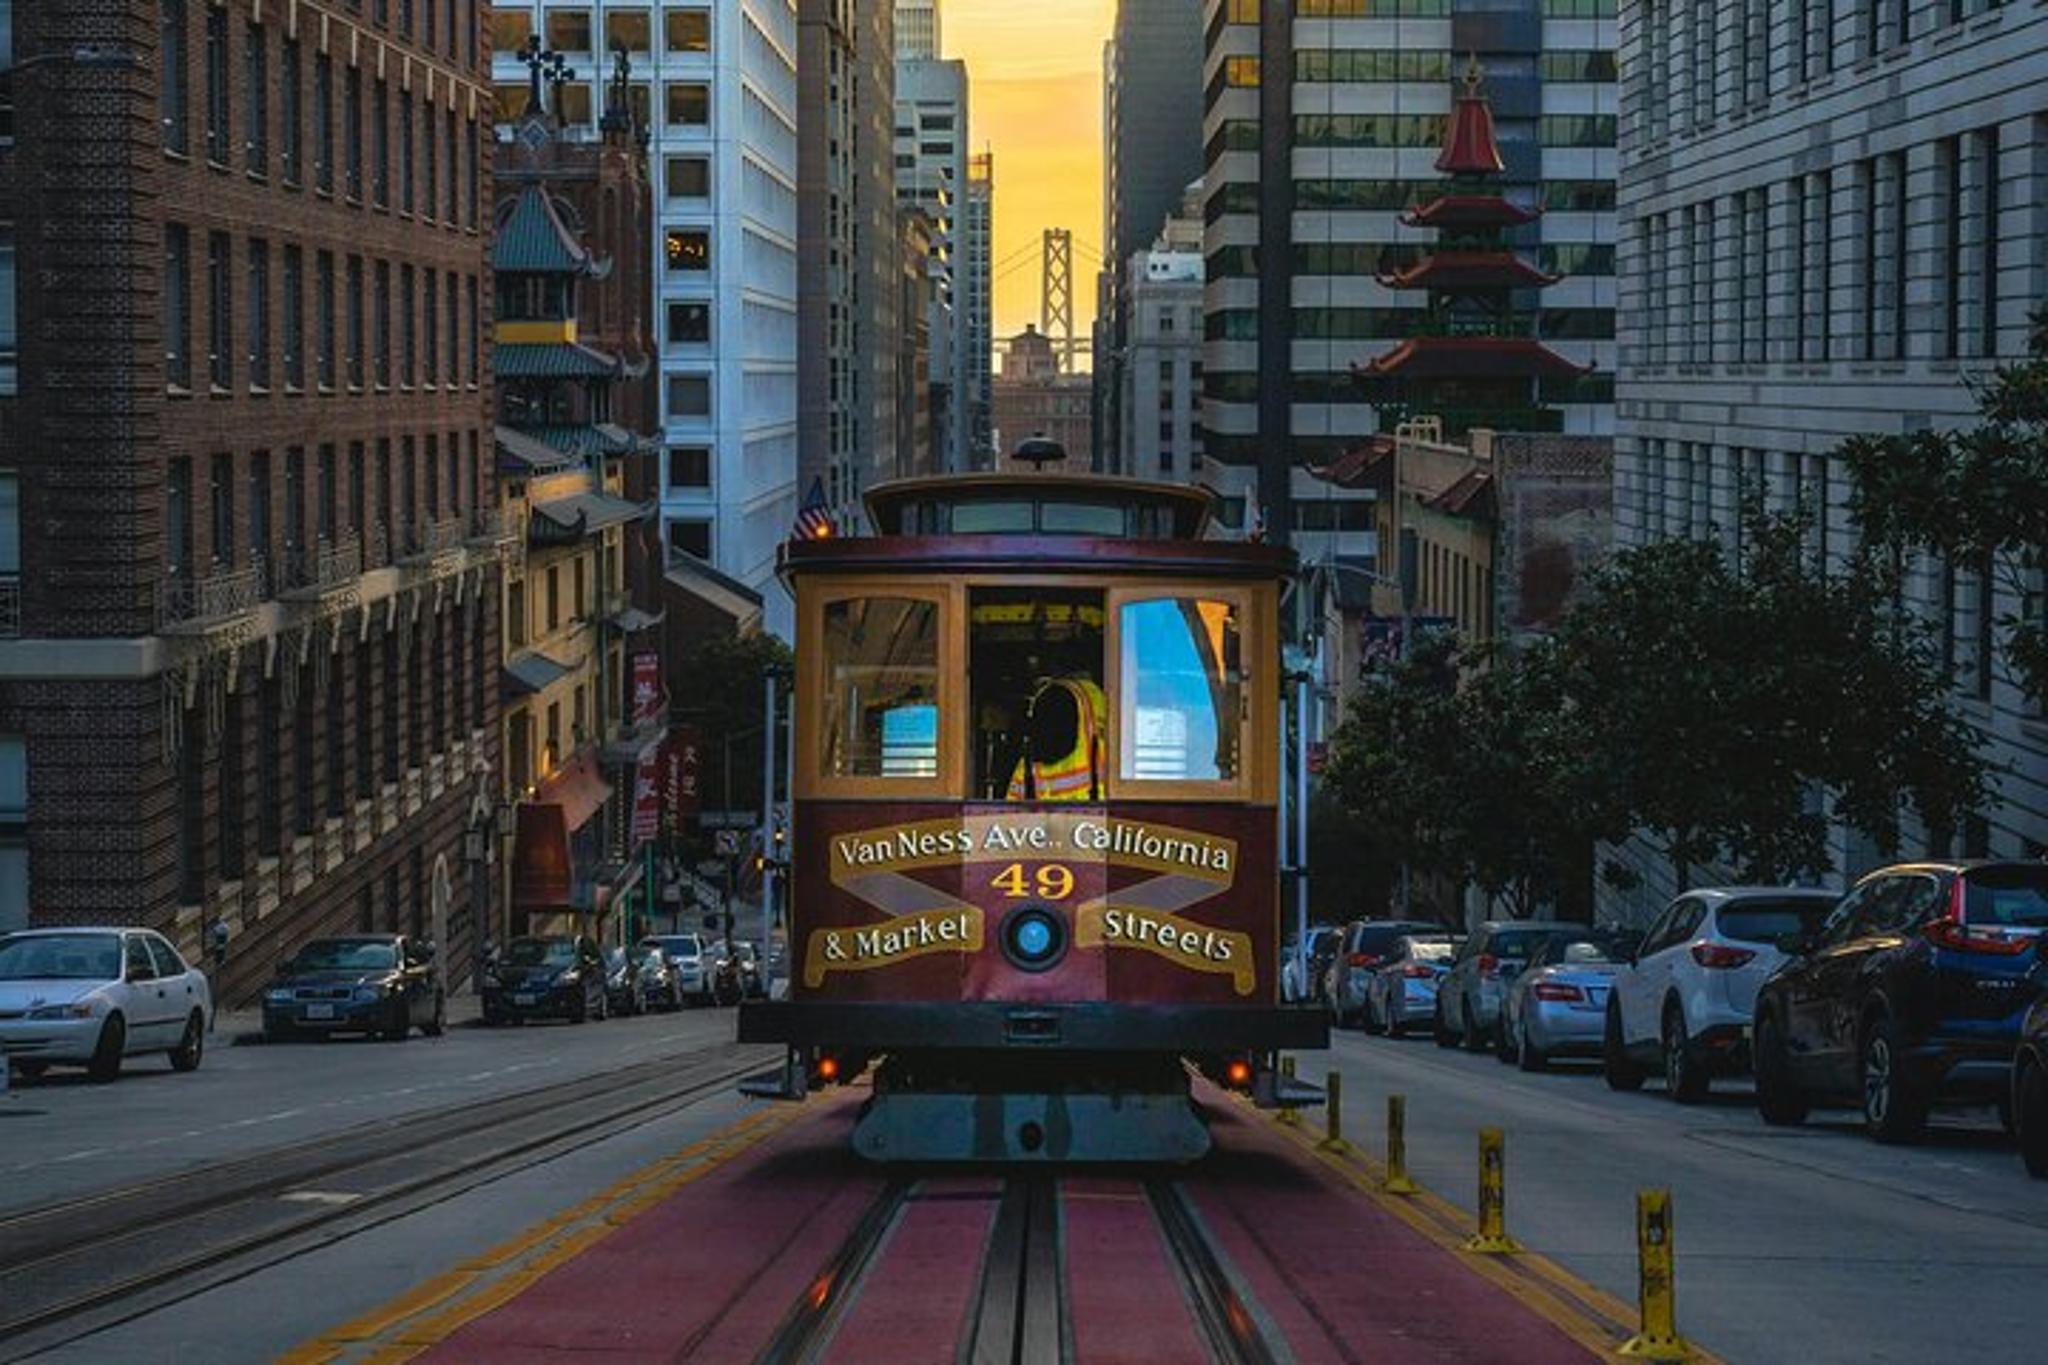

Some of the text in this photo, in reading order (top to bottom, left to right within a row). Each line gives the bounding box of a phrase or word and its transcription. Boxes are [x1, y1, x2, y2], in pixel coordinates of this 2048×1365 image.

[1073, 821, 1230, 871] California
[990, 862, 1074, 900] 49
[825, 909, 1233, 961] & Market Streets
